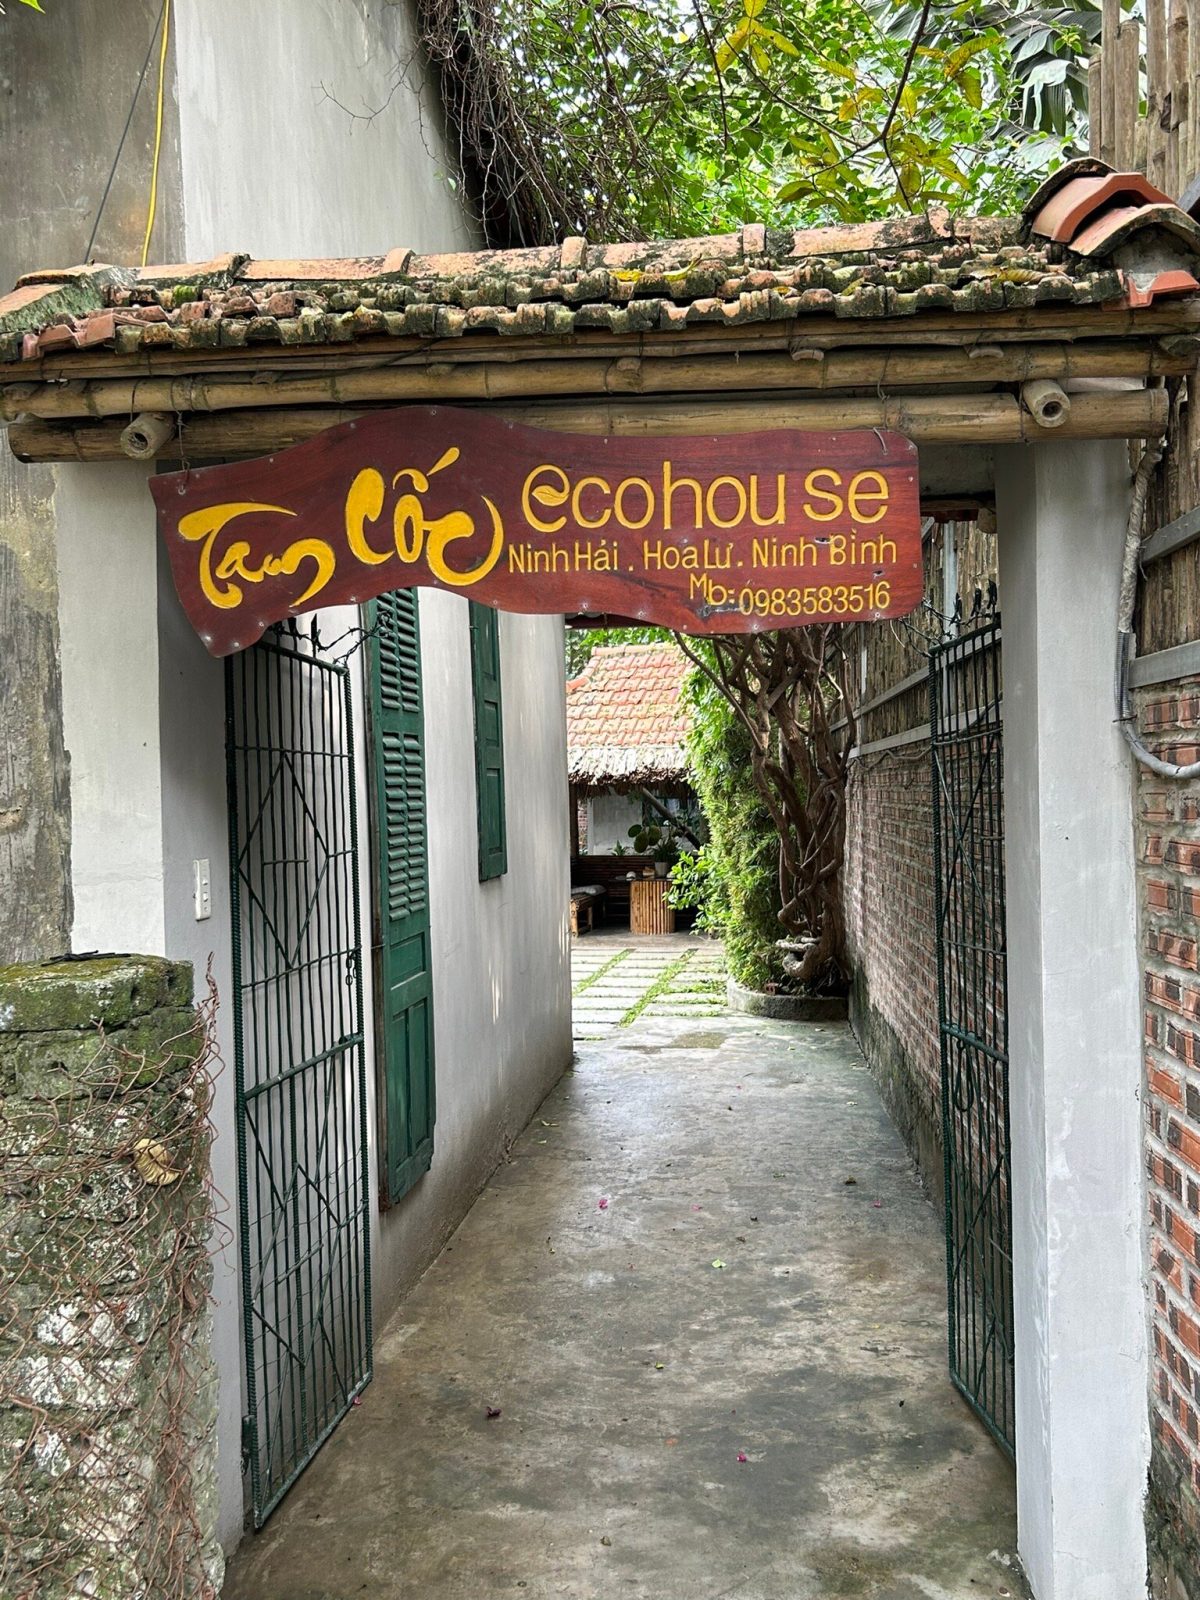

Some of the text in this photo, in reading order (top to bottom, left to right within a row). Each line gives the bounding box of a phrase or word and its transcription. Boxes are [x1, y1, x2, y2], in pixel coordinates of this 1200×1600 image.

[177, 447, 504, 609] Tam Cốc
[751, 535, 818, 569] Ninh
[828, 528, 897, 566] Bình
